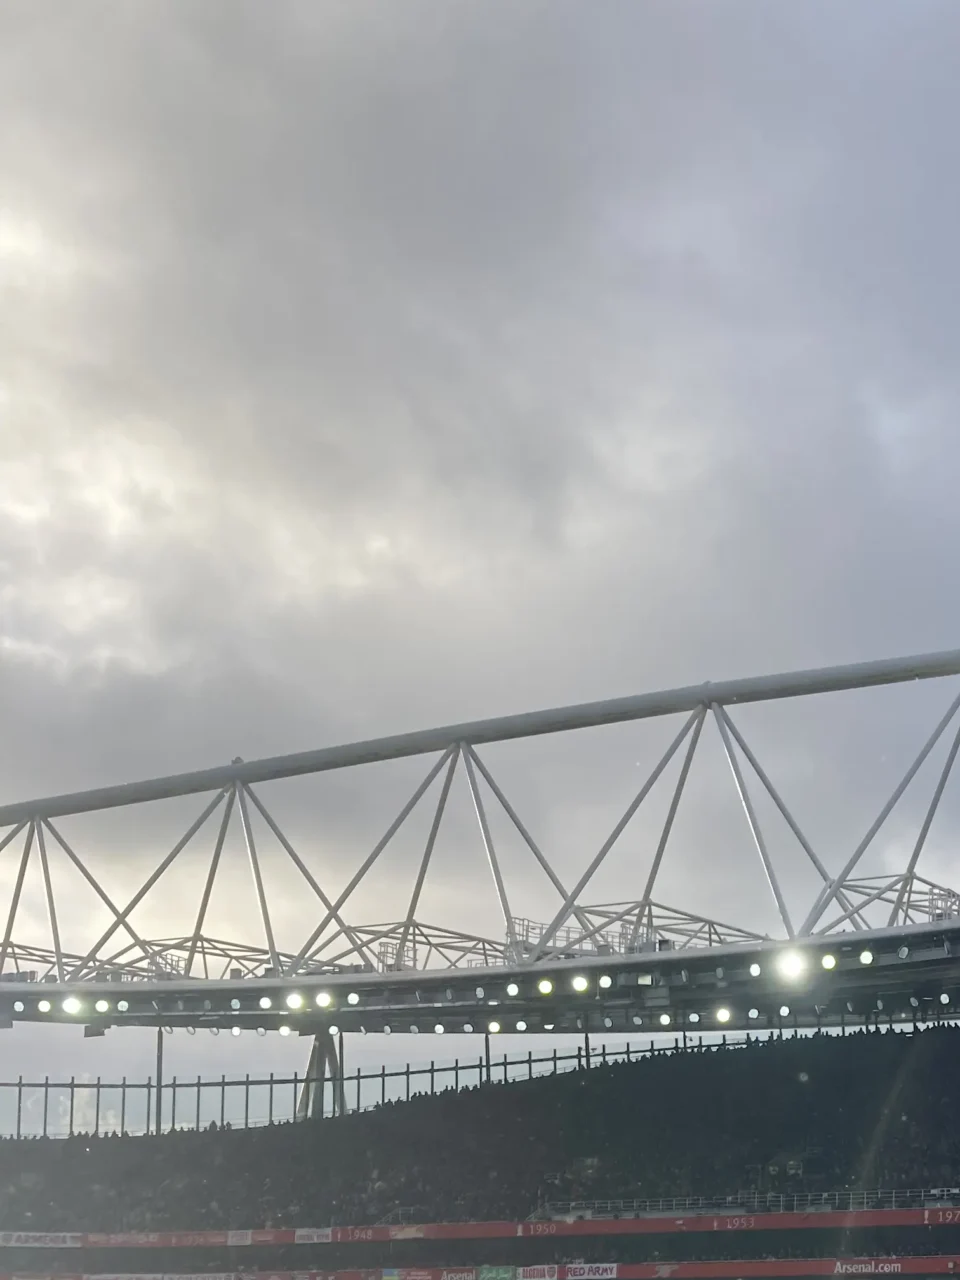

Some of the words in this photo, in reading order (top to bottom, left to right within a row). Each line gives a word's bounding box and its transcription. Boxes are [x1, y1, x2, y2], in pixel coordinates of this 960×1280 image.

[726, 1217, 755, 1229] 1953
[348, 1229, 373, 1240] 1948
[530, 1224, 556, 1235] 1950
[568, 1265, 585, 1277] RED
[587, 1264, 615, 1277] ARMY
[834, 1261, 901, 1273] Arsenal.com
